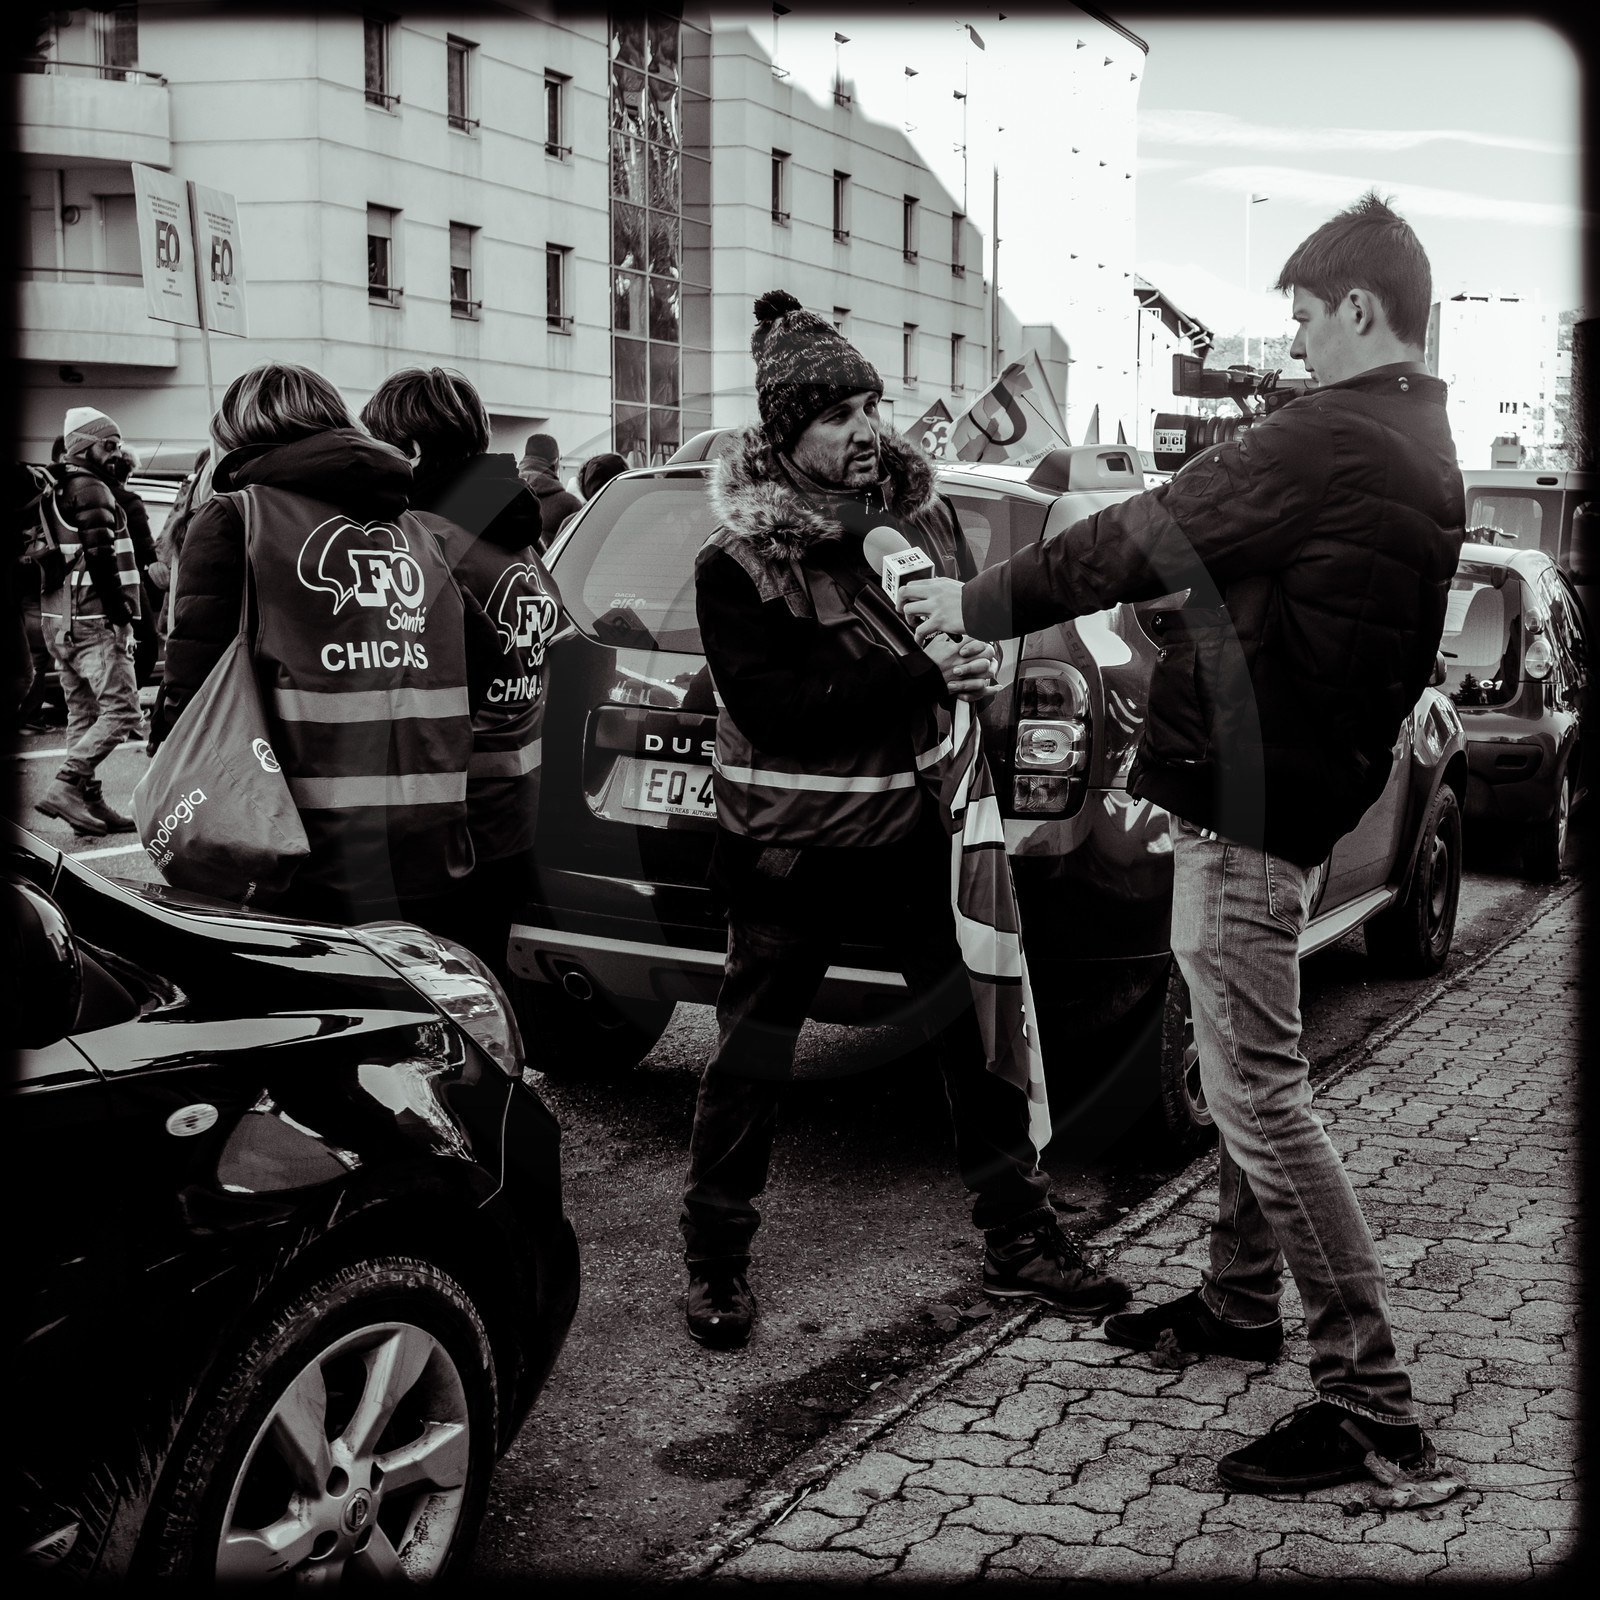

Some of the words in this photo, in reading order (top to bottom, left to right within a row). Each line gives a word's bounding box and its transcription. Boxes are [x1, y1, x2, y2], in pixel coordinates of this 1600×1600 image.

[155, 219, 180, 271] FO
[211, 235, 233, 284] FO
[348, 549, 424, 609] FO
[386, 602, 427, 633] Santé
[516, 596, 558, 647] FO
[610, 598, 635, 609] elf
[320, 640, 429, 672] CHICAS
[1480, 680, 1503, 690] C1
